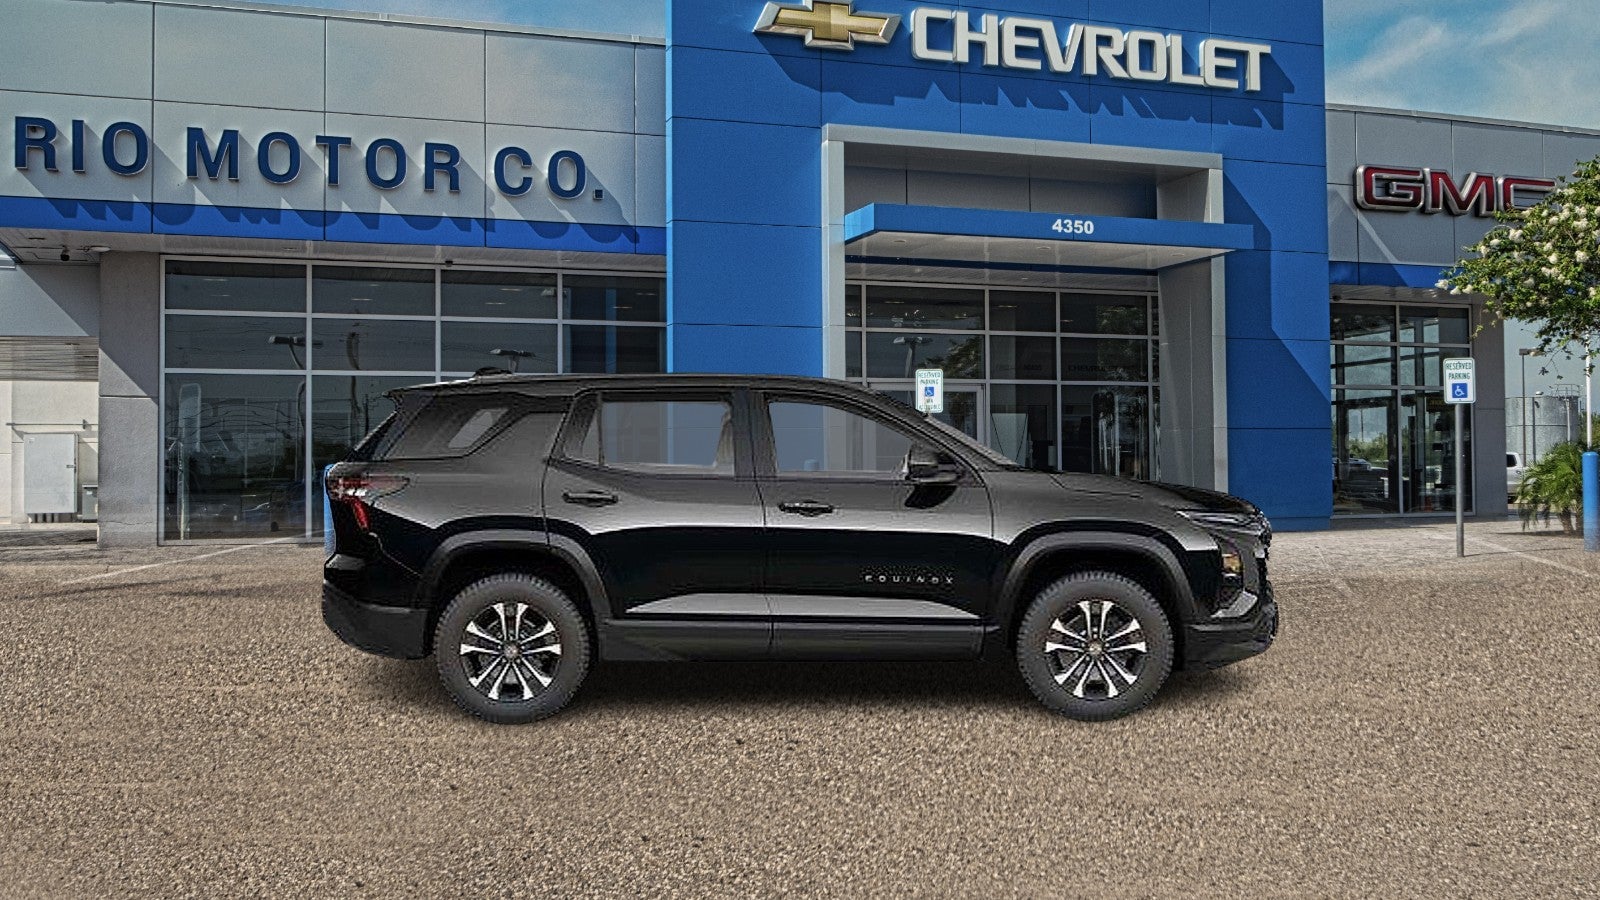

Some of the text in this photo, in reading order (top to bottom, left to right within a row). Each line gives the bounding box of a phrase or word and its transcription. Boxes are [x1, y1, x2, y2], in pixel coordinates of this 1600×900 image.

[910, 7, 1272, 92] CHEVROLET
[14, 115, 605, 199] RIO MOTOR CO.
[1353, 163, 1557, 217] GMC
[1052, 218, 1095, 235] 4350
[1445, 362, 1472, 370] RESERVED
[1448, 372, 1471, 380] PARKING
[864, 574, 954, 585] EQUINOX
